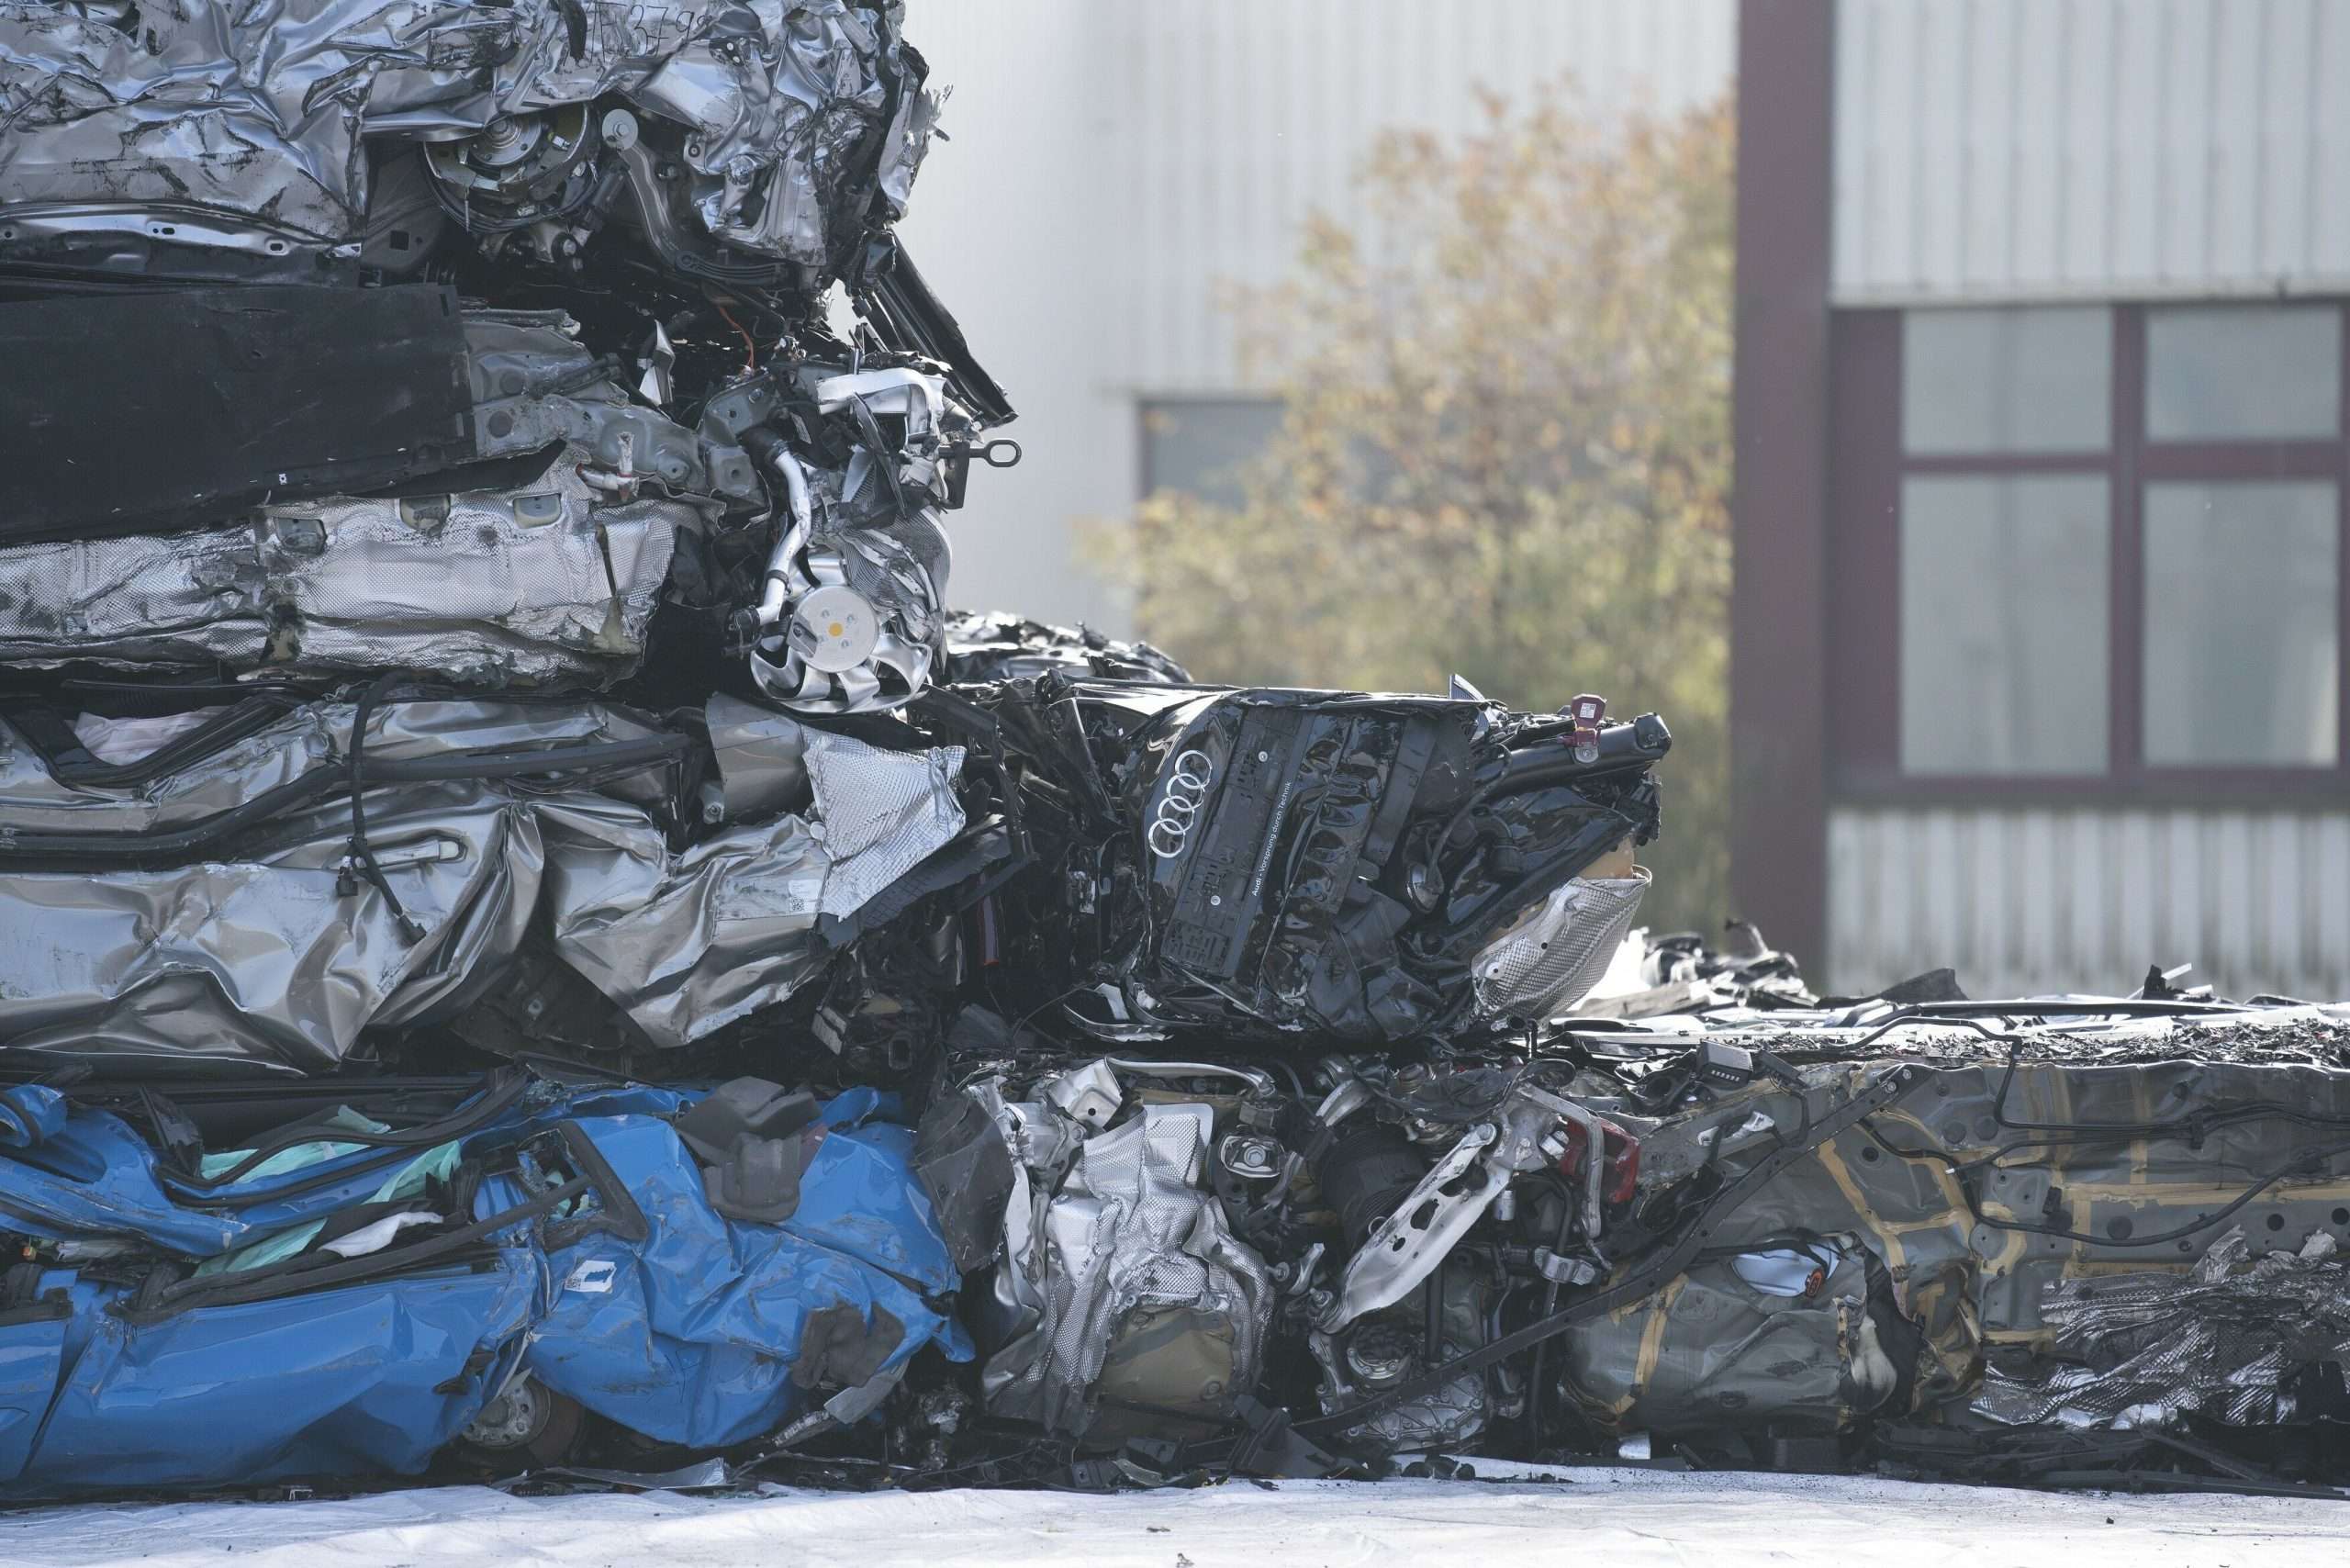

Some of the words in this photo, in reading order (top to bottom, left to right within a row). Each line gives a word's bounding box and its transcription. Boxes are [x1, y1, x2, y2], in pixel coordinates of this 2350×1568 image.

[1252, 878, 1262, 896] Audi
[1259, 834, 1277, 872] Vorsprung
[1271, 811, 1282, 833] durch
[1278, 781, 1292, 810] Technik
